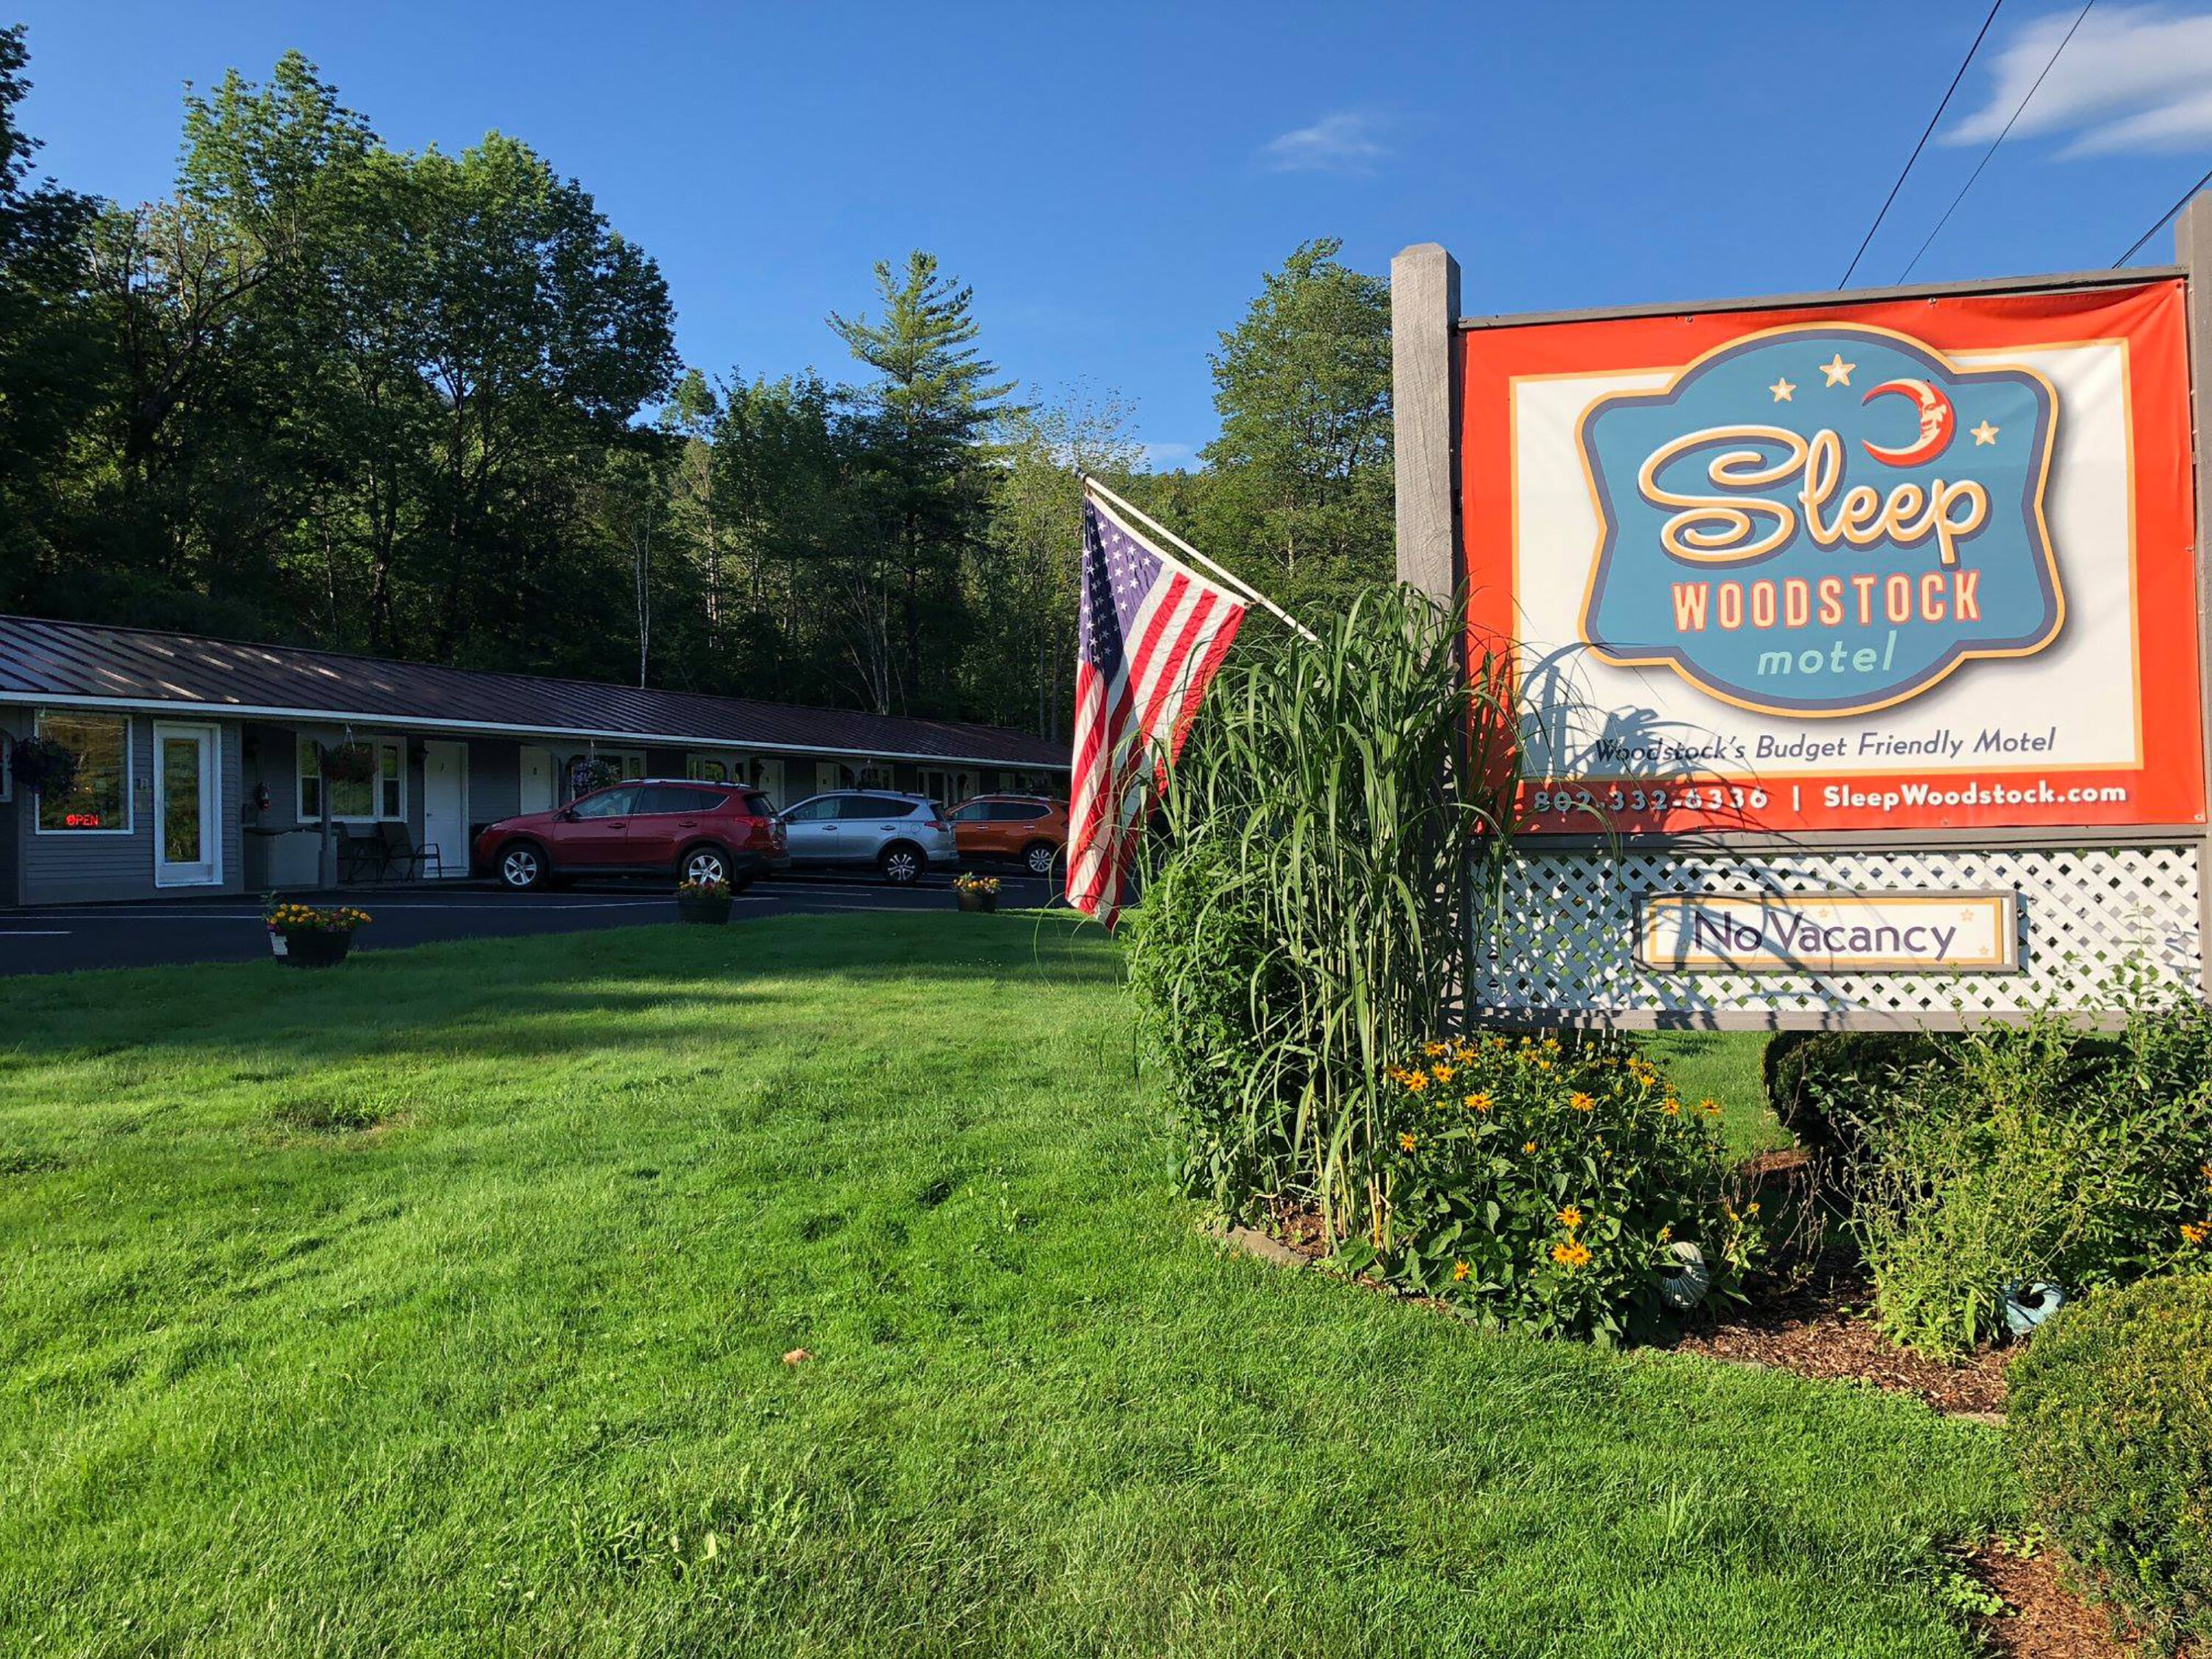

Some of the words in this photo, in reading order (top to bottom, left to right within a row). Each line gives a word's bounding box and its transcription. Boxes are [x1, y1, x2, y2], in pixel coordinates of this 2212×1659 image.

[1638, 425, 1990, 569] Sleep
[1671, 570, 1981, 632] WOODSTOCK
[1757, 630, 1897, 675] motel
[1595, 736, 1746, 762] Woodstock's
[1756, 734, 1846, 762] Budget
[1858, 729, 1964, 759] Friendly
[1973, 727, 2056, 754] Motel
[1823, 780, 2127, 811] SleepWoodstock.com
[66, 814, 99, 826] OPEN
[1695, 911, 1763, 953] No
[1768, 911, 1956, 961] Vacancy
